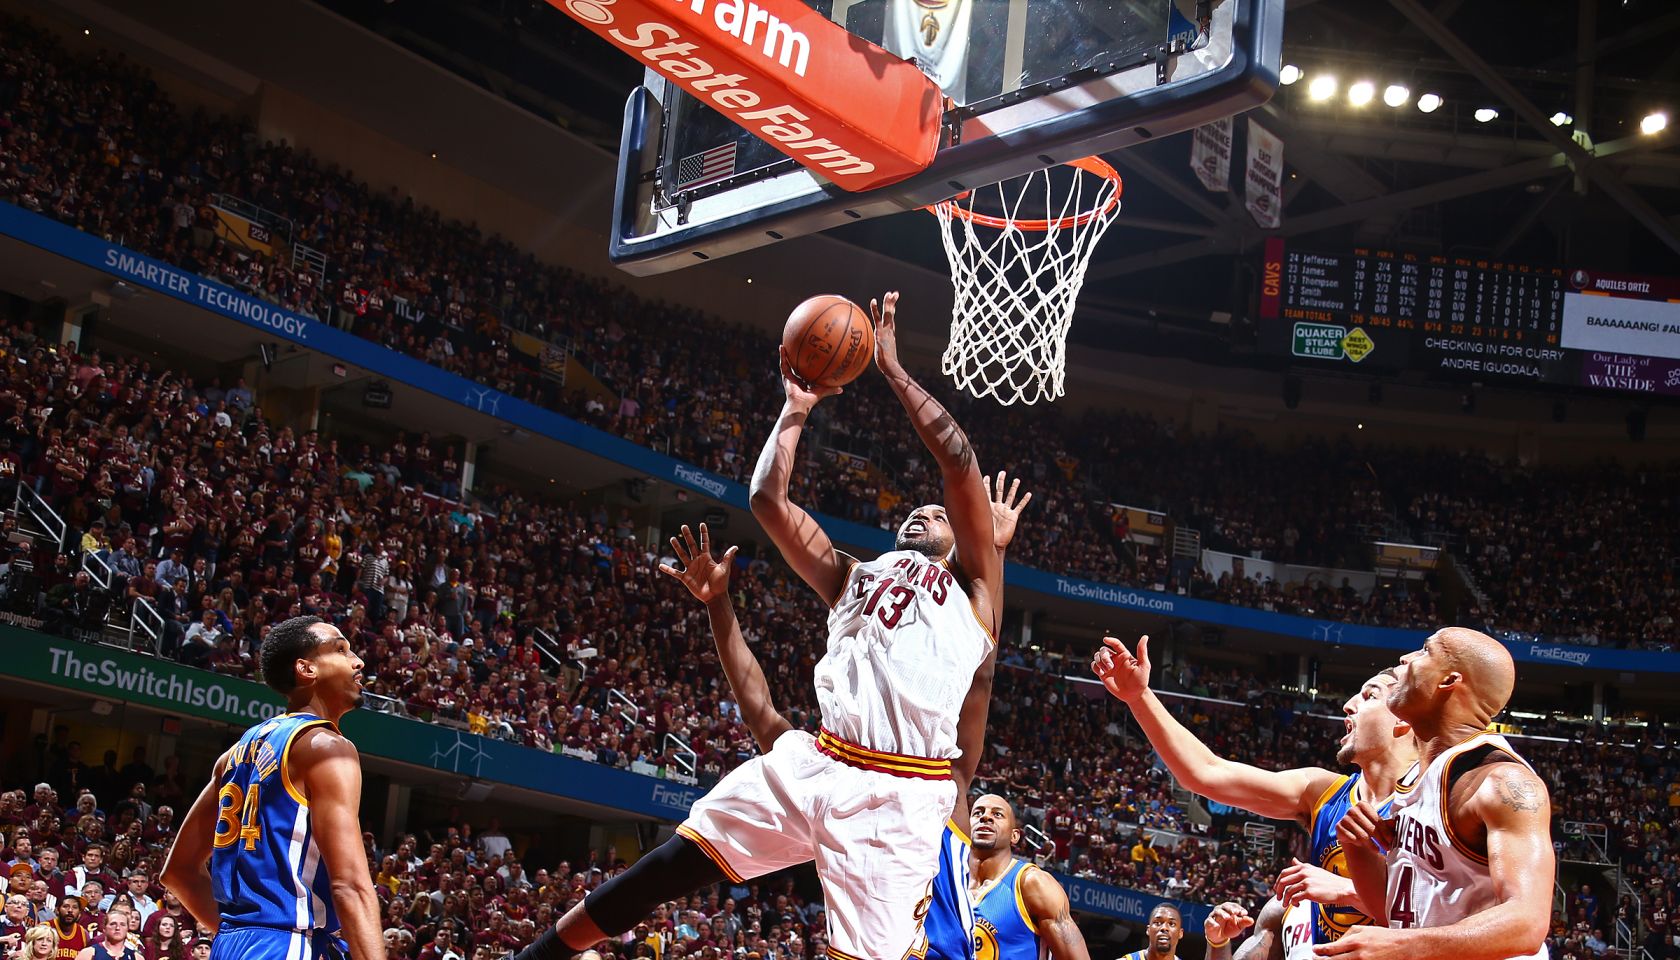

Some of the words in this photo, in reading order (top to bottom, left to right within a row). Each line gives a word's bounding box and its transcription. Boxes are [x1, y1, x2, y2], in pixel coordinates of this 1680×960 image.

[250, 227, 269, 243] 224
[1289, 253, 1298, 263] 24
[1302, 254, 1338, 266] Jefferson
[1356, 260, 1366, 269] 19
[1378, 263, 1390, 271] 2/4
[1401, 265, 1418, 275] 50%
[1431, 268, 1443, 277] 1/2
[1455, 270, 1468, 279] 0/0
[1263, 262, 1280, 296] CAVS
[1288, 264, 1298, 274] 23
[1302, 265, 1325, 276] James
[1355, 271, 1365, 280] 20
[1375, 273, 1392, 283] 5/12
[1400, 276, 1417, 286] 41%
[1430, 279, 1443, 288] 0/0
[1454, 281, 1467, 290] 0/0
[1493, 285, 1499, 294] 2
[1506, 286, 1512, 295] 2
[1519, 287, 1524, 296] 0
[1551, 291, 1560, 300] 10
[1595, 279, 1627, 291] AQUILES
[105, 249, 190, 295] SMARTER
[198, 283, 307, 339] TECHNOLOGY.
[1300, 286, 1321, 297] Smith
[1354, 292, 1362, 301] 17
[1452, 302, 1465, 311] 0/0
[1476, 305, 1482, 313] 2
[1504, 307, 1510, 316] 0
[1301, 276, 1338, 288] Thompson
[1376, 283, 1389, 293] 2/3
[1429, 289, 1442, 298] 0/0
[1453, 292, 1466, 301] 2/2
[1506, 297, 1511, 305] 0
[1531, 300, 1540, 308] 10
[1284, 309, 1305, 320] TEAM
[1306, 311, 1332, 322] TOTALS
[1300, 297, 1344, 310] Dellavedova
[1354, 303, 1359, 311] 4
[1375, 305, 1387, 313] 0/0
[1400, 307, 1412, 316] 0%
[1427, 310, 1440, 319] 0/0
[1452, 312, 1464, 321] 0/0
[1475, 315, 1481, 323] 0
[1504, 318, 1509, 326] 0
[1550, 322, 1555, 331] 0
[1296, 328, 1343, 338] QUAKER
[1305, 338, 1337, 348] STEAK
[1312, 347, 1334, 356] LUBE
[1346, 342, 1367, 350] WINGS
[1425, 337, 1483, 354] CHECKING
[1486, 342, 1498, 354] IN
[1500, 344, 1523, 358] FOR
[1525, 346, 1565, 361] CURRY
[1441, 357, 1480, 371] ANDRE
[1593, 353, 1612, 362] Our
[1614, 354, 1637, 366] Lady
[1640, 358, 1650, 366] of
[1604, 364, 1636, 378] THE
[1589, 374, 1655, 392] WAYSIDE
[674, 464, 727, 497] FirstEnergy
[863, 577, 916, 630] 13
[1056, 578, 1174, 612] TheSwitchIsOn.com
[0, 611, 44, 628] untington
[1530, 645, 1590, 665] FirstEnergy
[213, 782, 261, 851] 34
[1068, 884, 1080, 902] IS
[1084, 888, 1145, 917] CHANGING.
[977, 916, 998, 935] STATE
